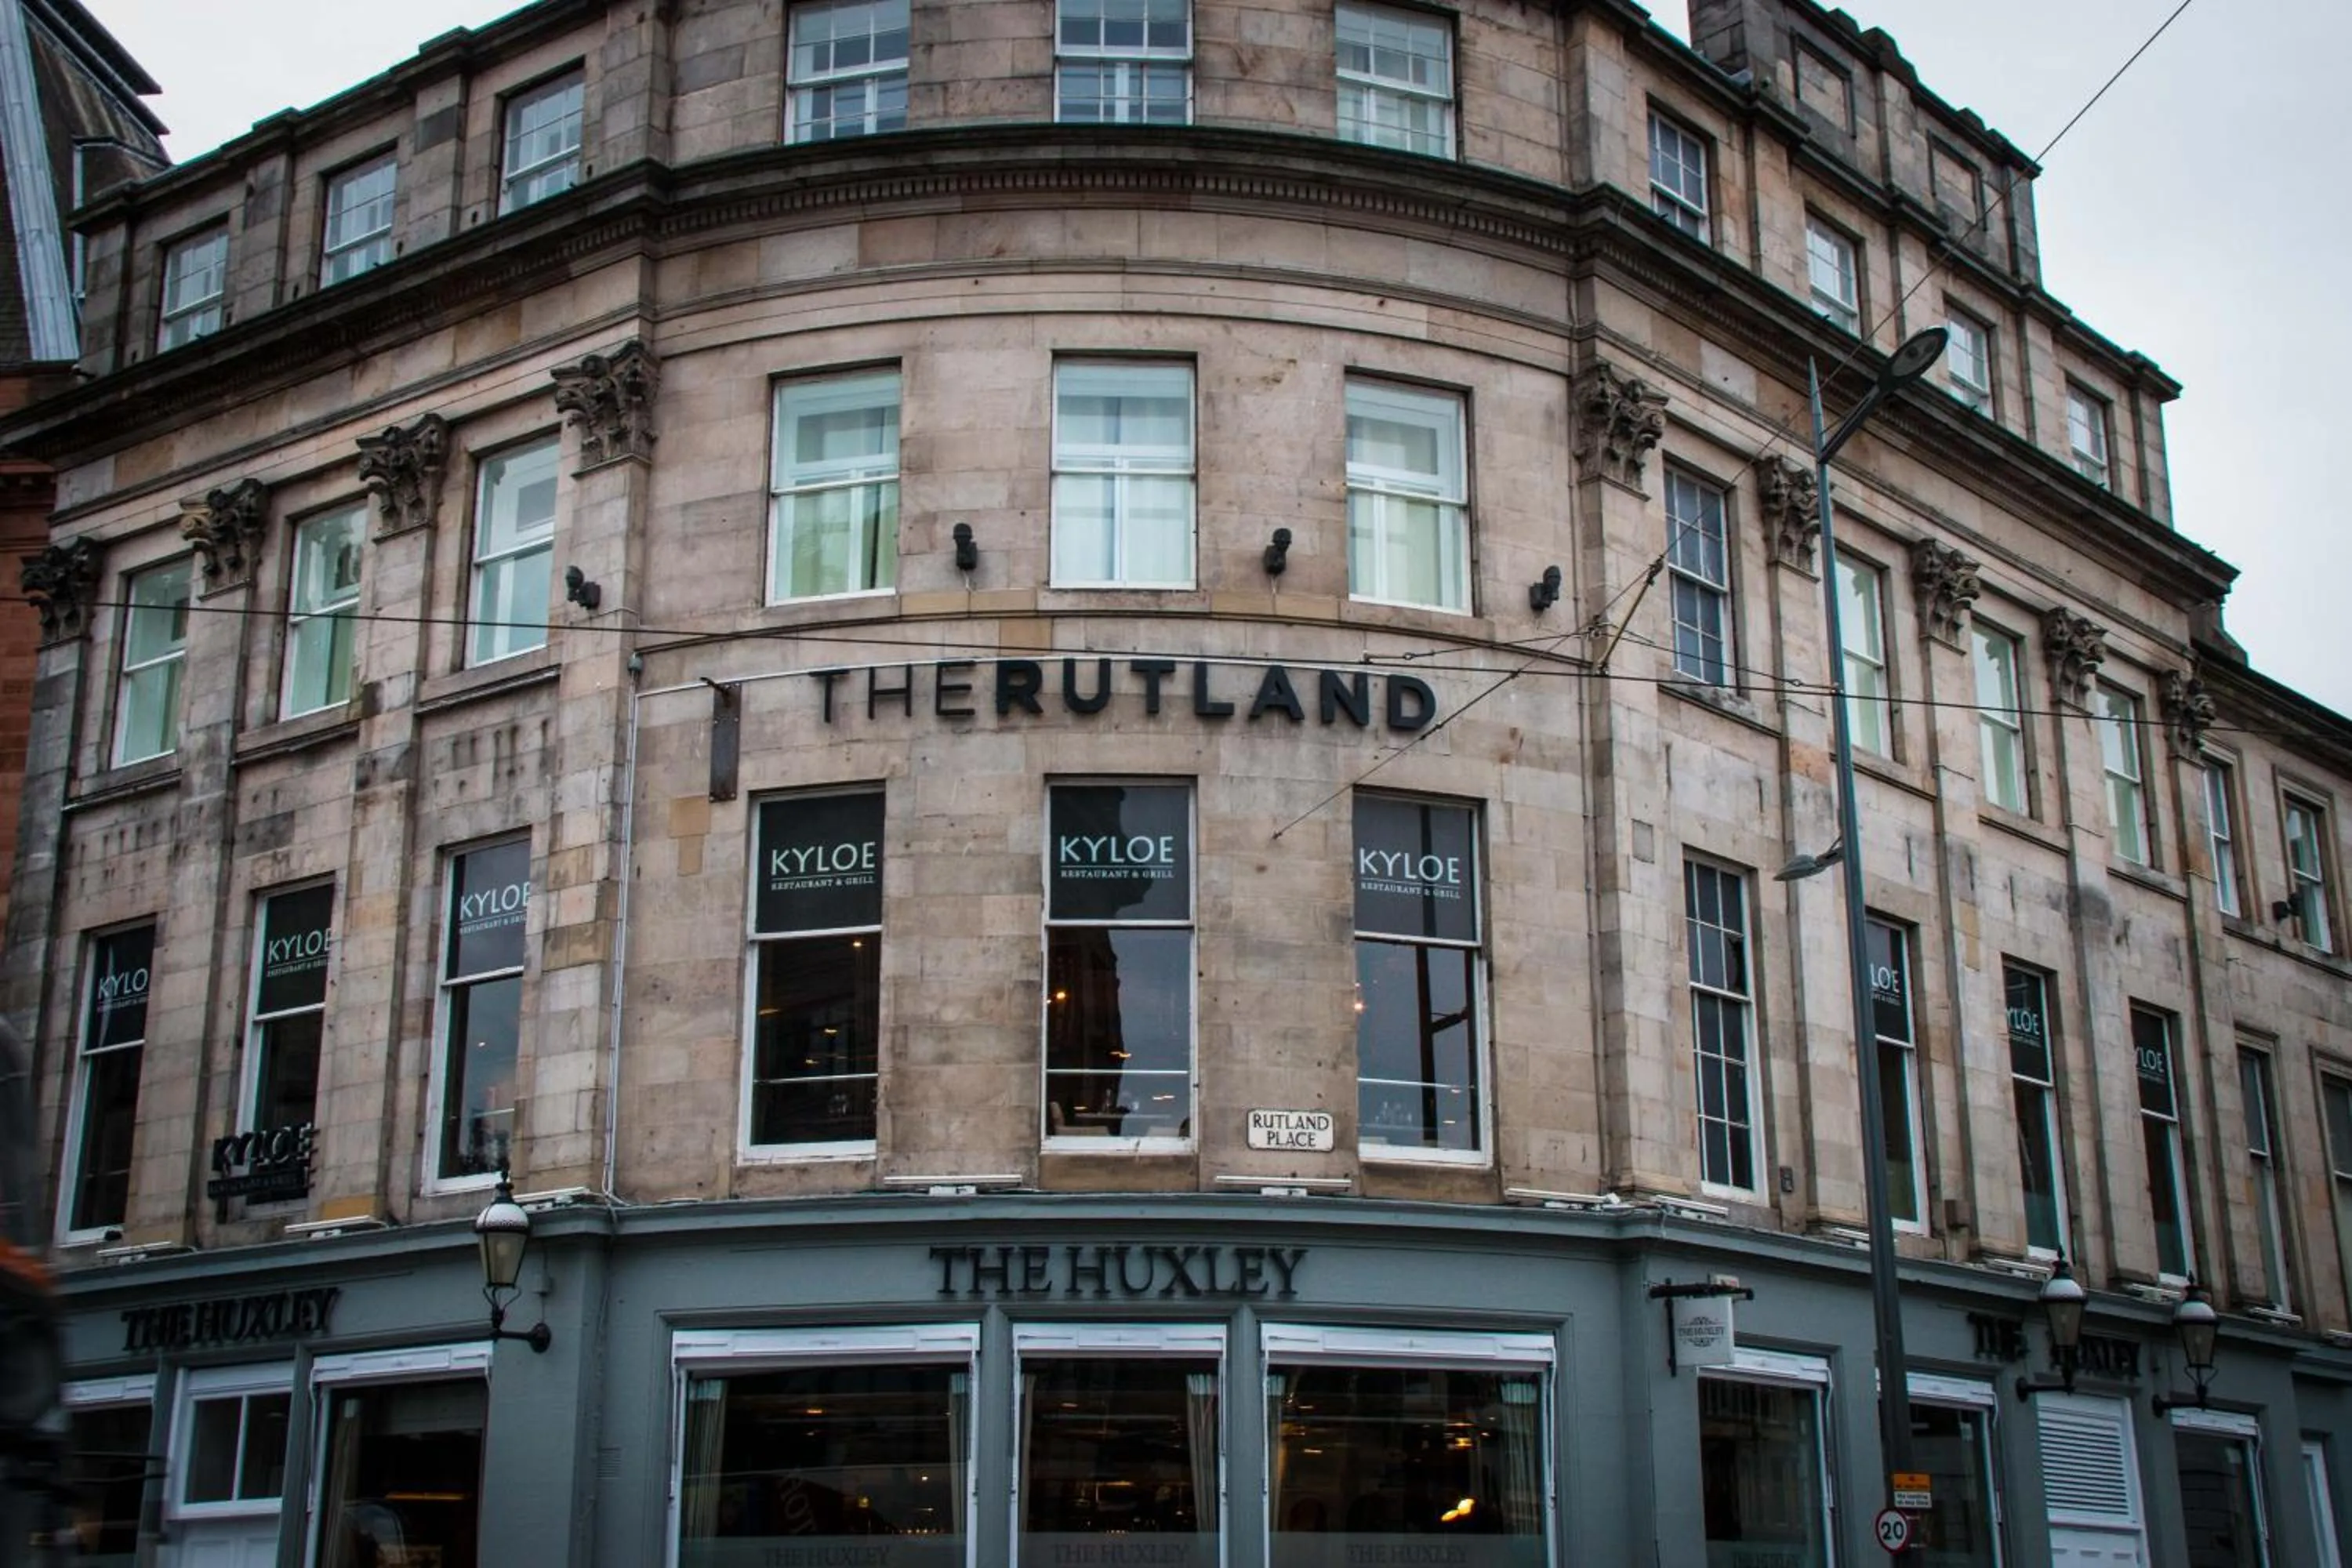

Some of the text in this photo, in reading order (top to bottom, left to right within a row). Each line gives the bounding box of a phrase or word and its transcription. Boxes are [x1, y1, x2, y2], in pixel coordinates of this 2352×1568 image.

[771, 841, 876, 876] KYLOE
[1060, 835, 1174, 863] KYLOE
[1061, 869, 1174, 879] RESTAURANT & GRILL
[1359, 848, 1461, 884] KYLOE
[771, 878, 833, 891] RESTAURANT
[845, 875, 874, 885] GRILL
[1360, 881, 1421, 895] RESTAURANT
[1432, 887, 1461, 899] GRILL
[459, 880, 531, 921] KYLOE
[267, 927, 332, 965] KYLOE
[99, 967, 148, 1000] KYLO
[1870, 962, 1900, 993] LOE
[1253, 1112, 1330, 1131] RUTLAND
[212, 1121, 314, 1175] KYLOE
[1267, 1130, 1317, 1147] PLACE
[930, 1245, 1308, 1297] THE HUXLEY
[196, 1287, 339, 1343] HUXLEY
[1881, 1521, 1904, 1541] 20
